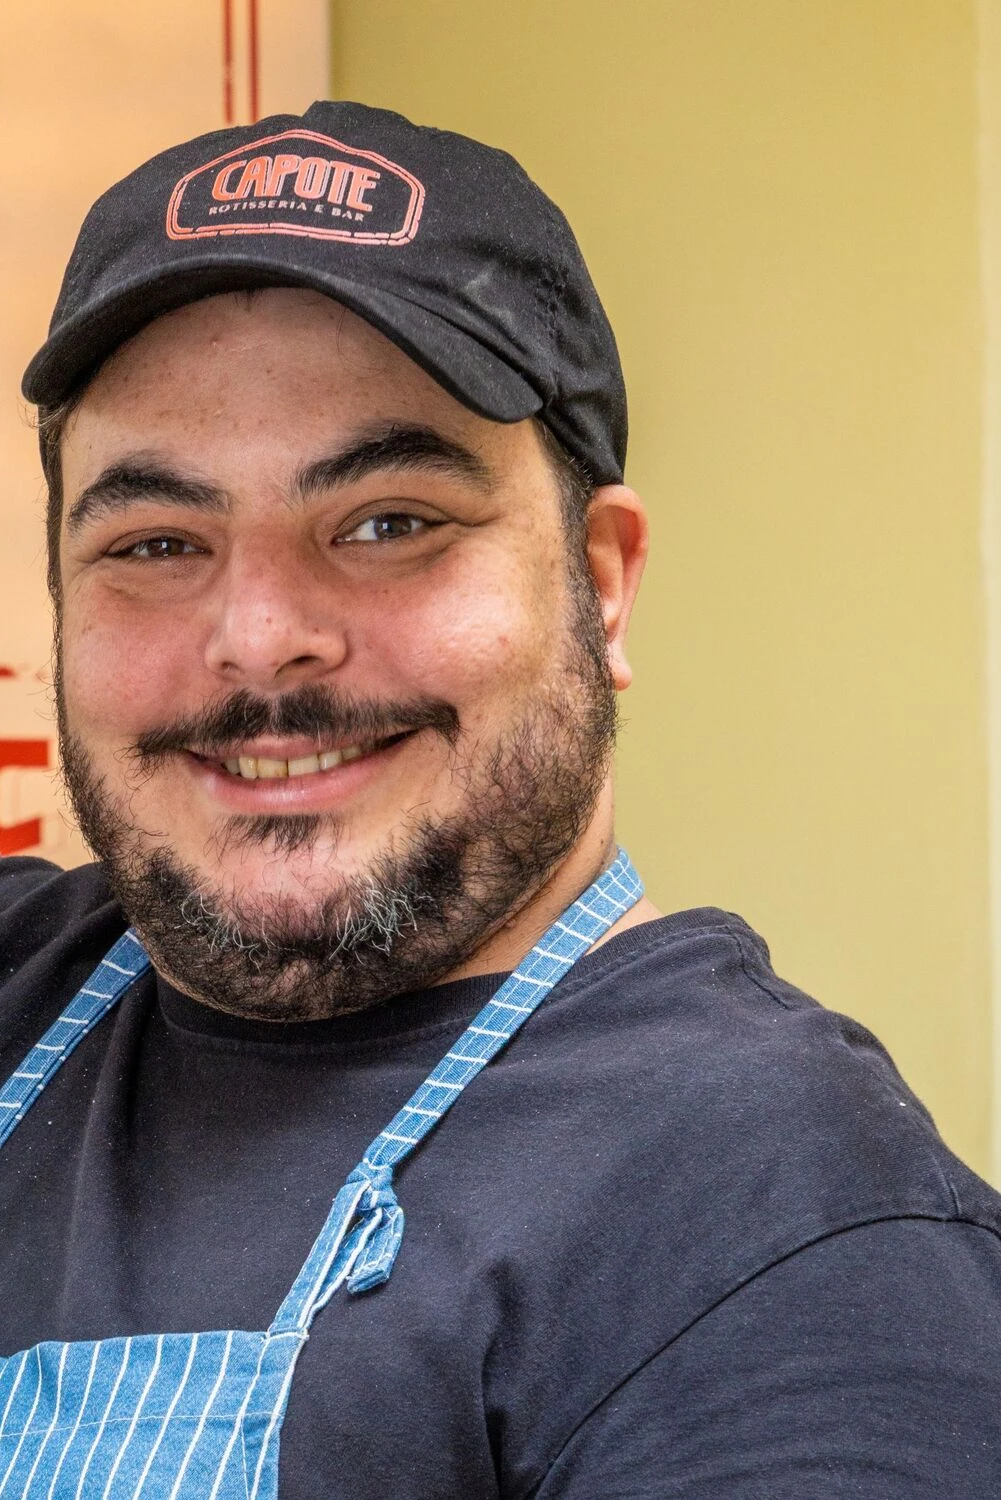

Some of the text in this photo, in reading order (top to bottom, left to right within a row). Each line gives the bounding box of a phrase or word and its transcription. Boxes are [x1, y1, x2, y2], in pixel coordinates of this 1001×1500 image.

[211, 153, 381, 213] CAPOTE
[208, 200, 365, 222] ROTISSERIA E BAR
